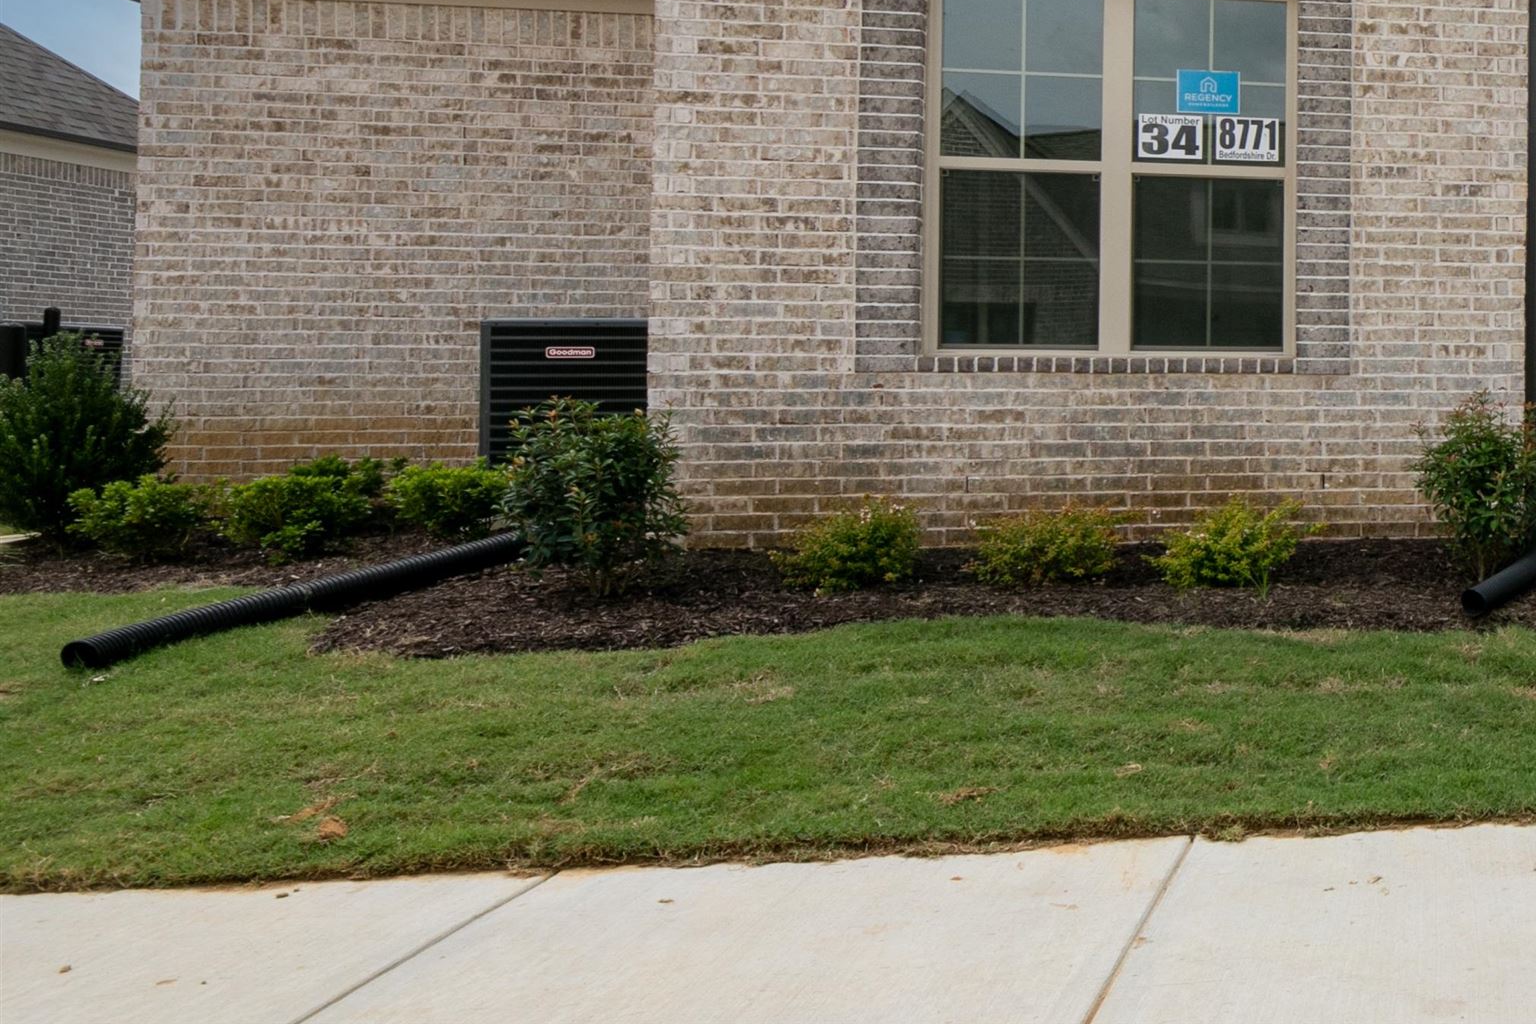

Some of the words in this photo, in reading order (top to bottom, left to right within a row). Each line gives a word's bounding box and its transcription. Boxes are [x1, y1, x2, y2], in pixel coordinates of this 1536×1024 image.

[1184, 92, 1232, 102] REGENCY
[1141, 115, 1157, 124] Lot
[1161, 116, 1200, 125] Number
[1219, 118, 1276, 150] 8771
[1142, 124, 1200, 156] 34
[1219, 150, 1265, 160] Bedfordshire
